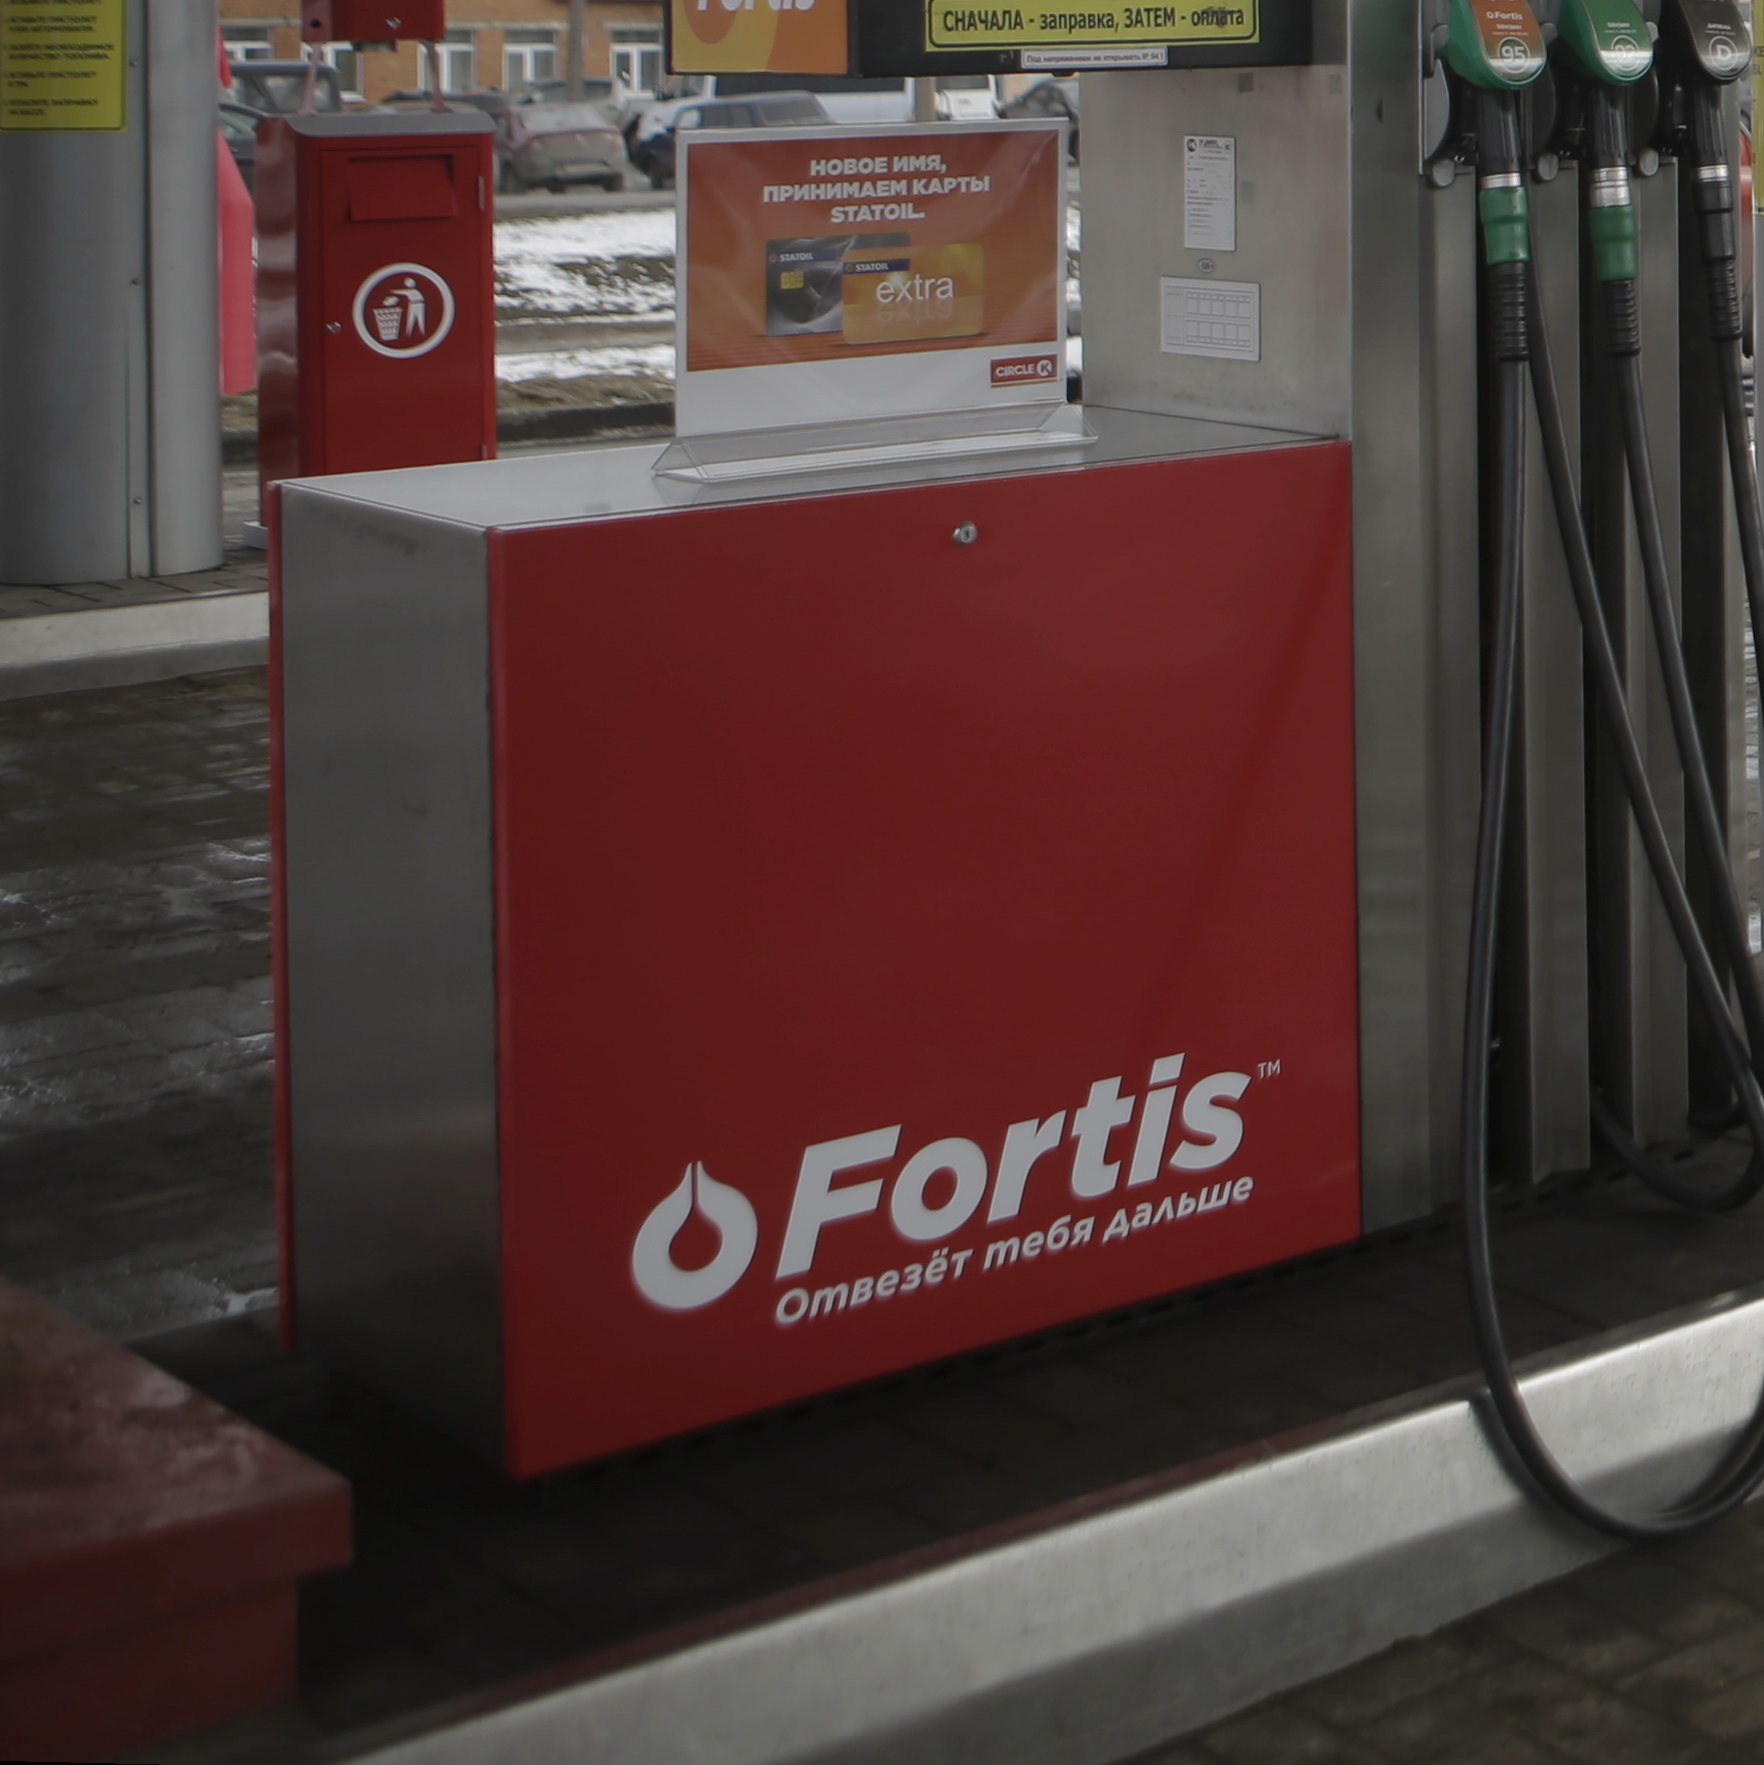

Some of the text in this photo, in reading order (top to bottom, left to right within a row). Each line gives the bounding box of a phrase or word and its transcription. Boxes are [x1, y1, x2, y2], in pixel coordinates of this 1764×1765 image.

[943, 10, 1024, 32] СНАЧАЛА
[1039, 13, 1119, 34] заправка,
[1123, 7, 1175, 28] ЗАТЕМ
[1191, 8, 1244, 27] оплата
[1495, 11, 1523, 20] Fortis
[1501, 46, 1525, 63] 95
[1716, 44, 1732, 60] D
[810, 154, 947, 176] НОВОЕ ИМЯ,
[763, 176, 990, 202] ПРИНИМАЕМ КАРТЫ
[830, 203, 926, 223] STATOIL.
[779, 252, 814, 263] STATOIL
[855, 262, 889, 272] STATOIL
[876, 276, 954, 304] extra
[996, 360, 1052, 376] CIRCLE K
[776, 1053, 1251, 1280] Fortis
[775, 1248, 974, 1326] Отвезёт
[983, 1215, 1095, 1272] тебя
